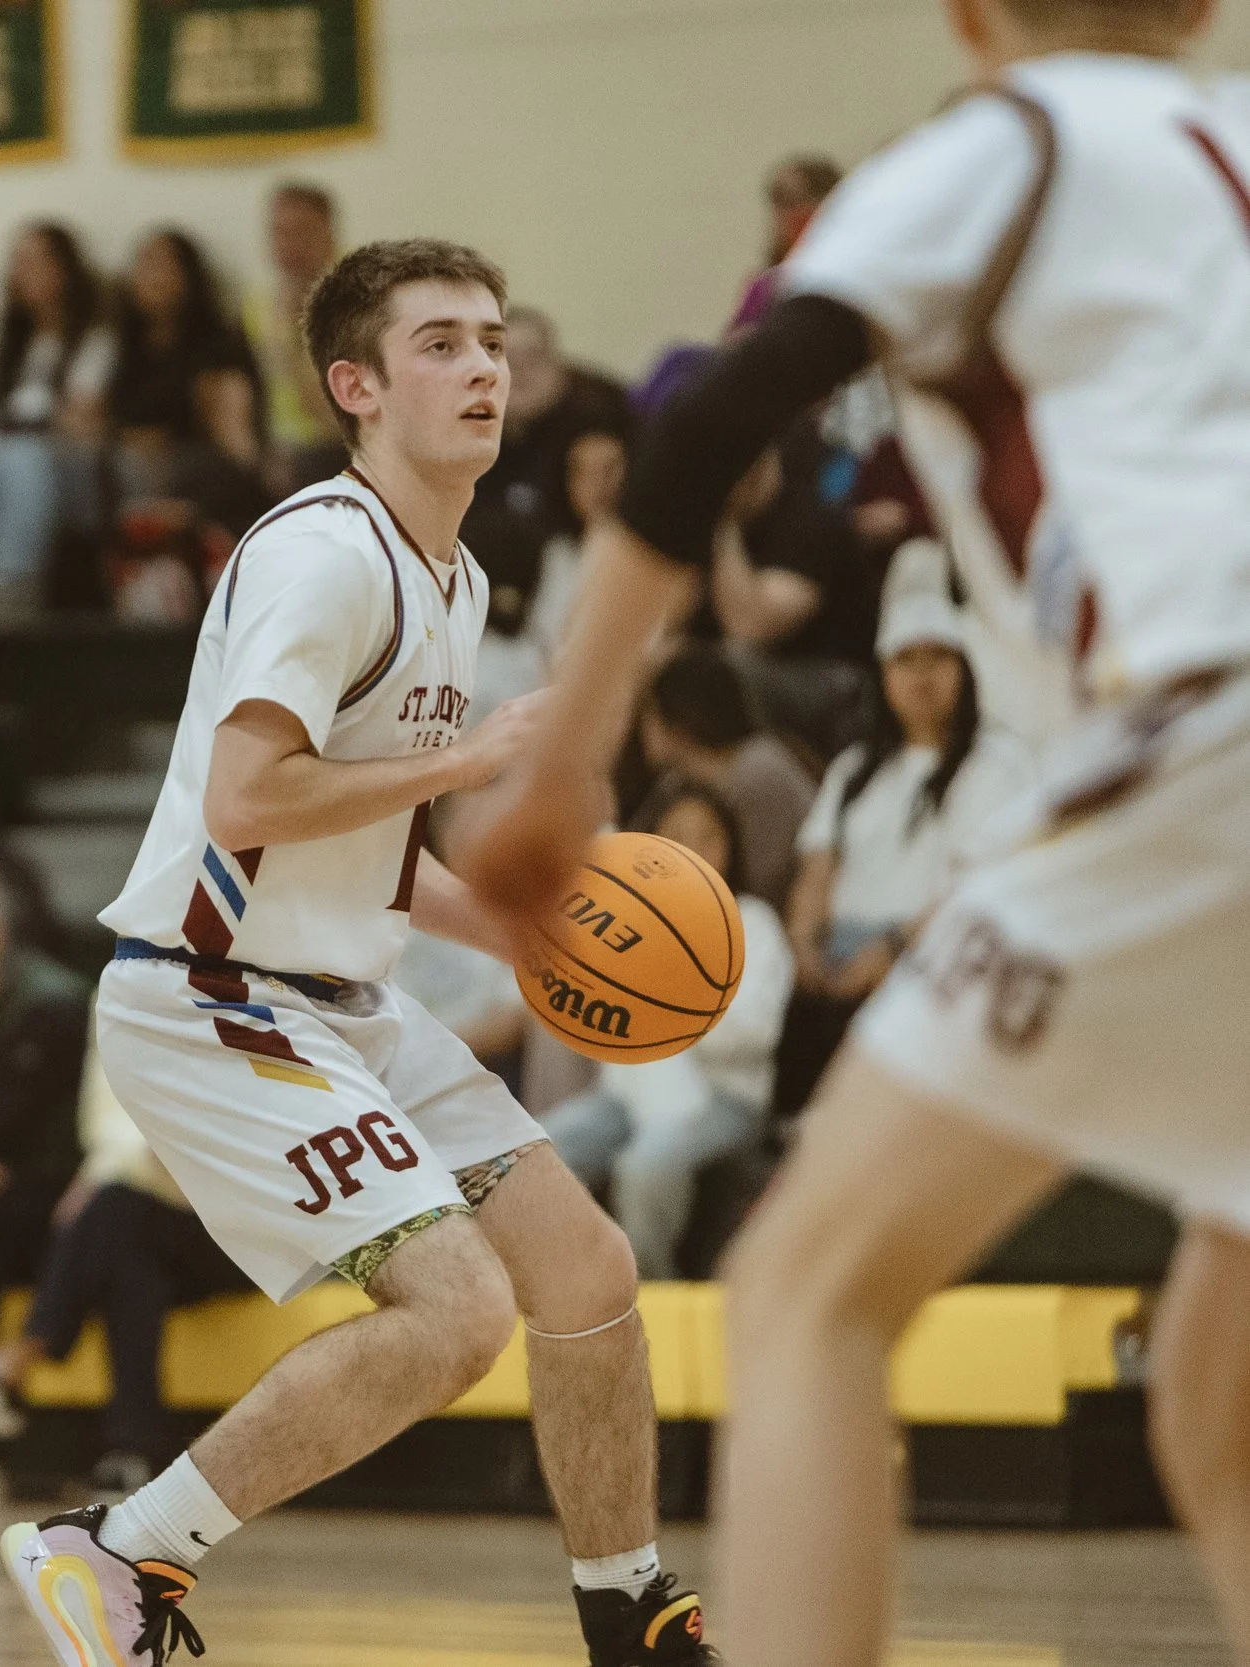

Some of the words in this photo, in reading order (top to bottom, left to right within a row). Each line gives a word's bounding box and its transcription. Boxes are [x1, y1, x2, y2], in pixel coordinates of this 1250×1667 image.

[398, 686, 428, 722] ST.
[538, 967, 631, 1037] Wils
[284, 1110, 419, 1215] JPG
